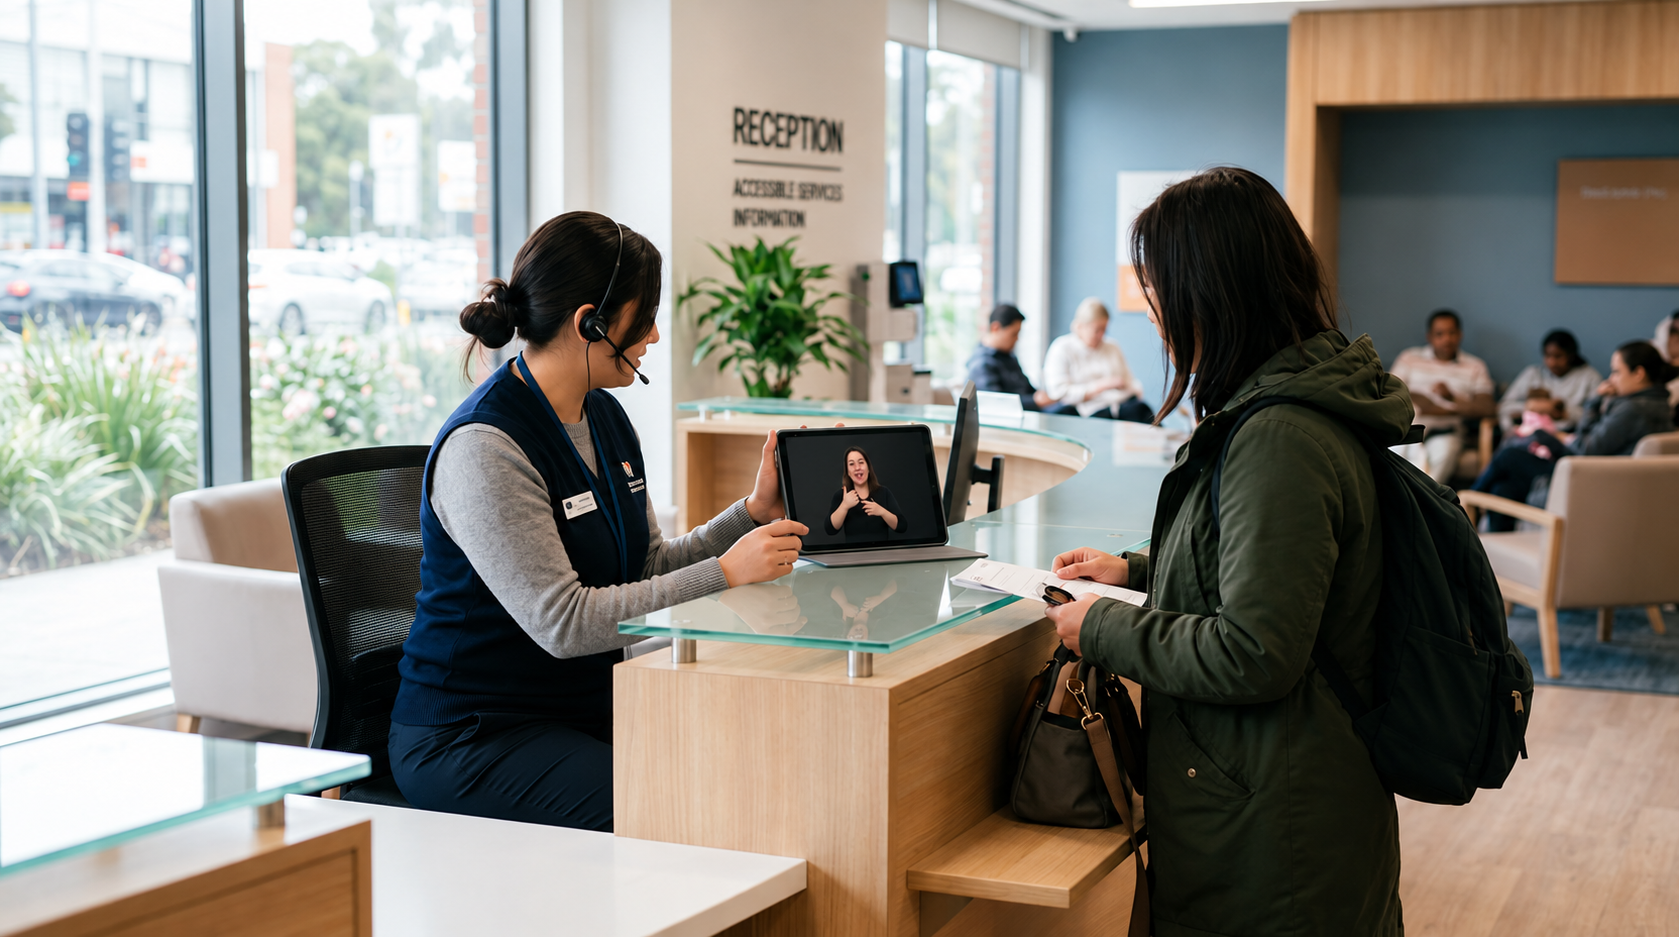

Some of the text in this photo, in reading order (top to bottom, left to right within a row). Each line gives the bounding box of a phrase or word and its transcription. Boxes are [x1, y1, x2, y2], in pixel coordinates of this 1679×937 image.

[733, 107, 844, 153] RECEPTION
[733, 178, 843, 202] ACCESSIBLE SERVICES
[733, 208, 806, 228] INFORMATION
